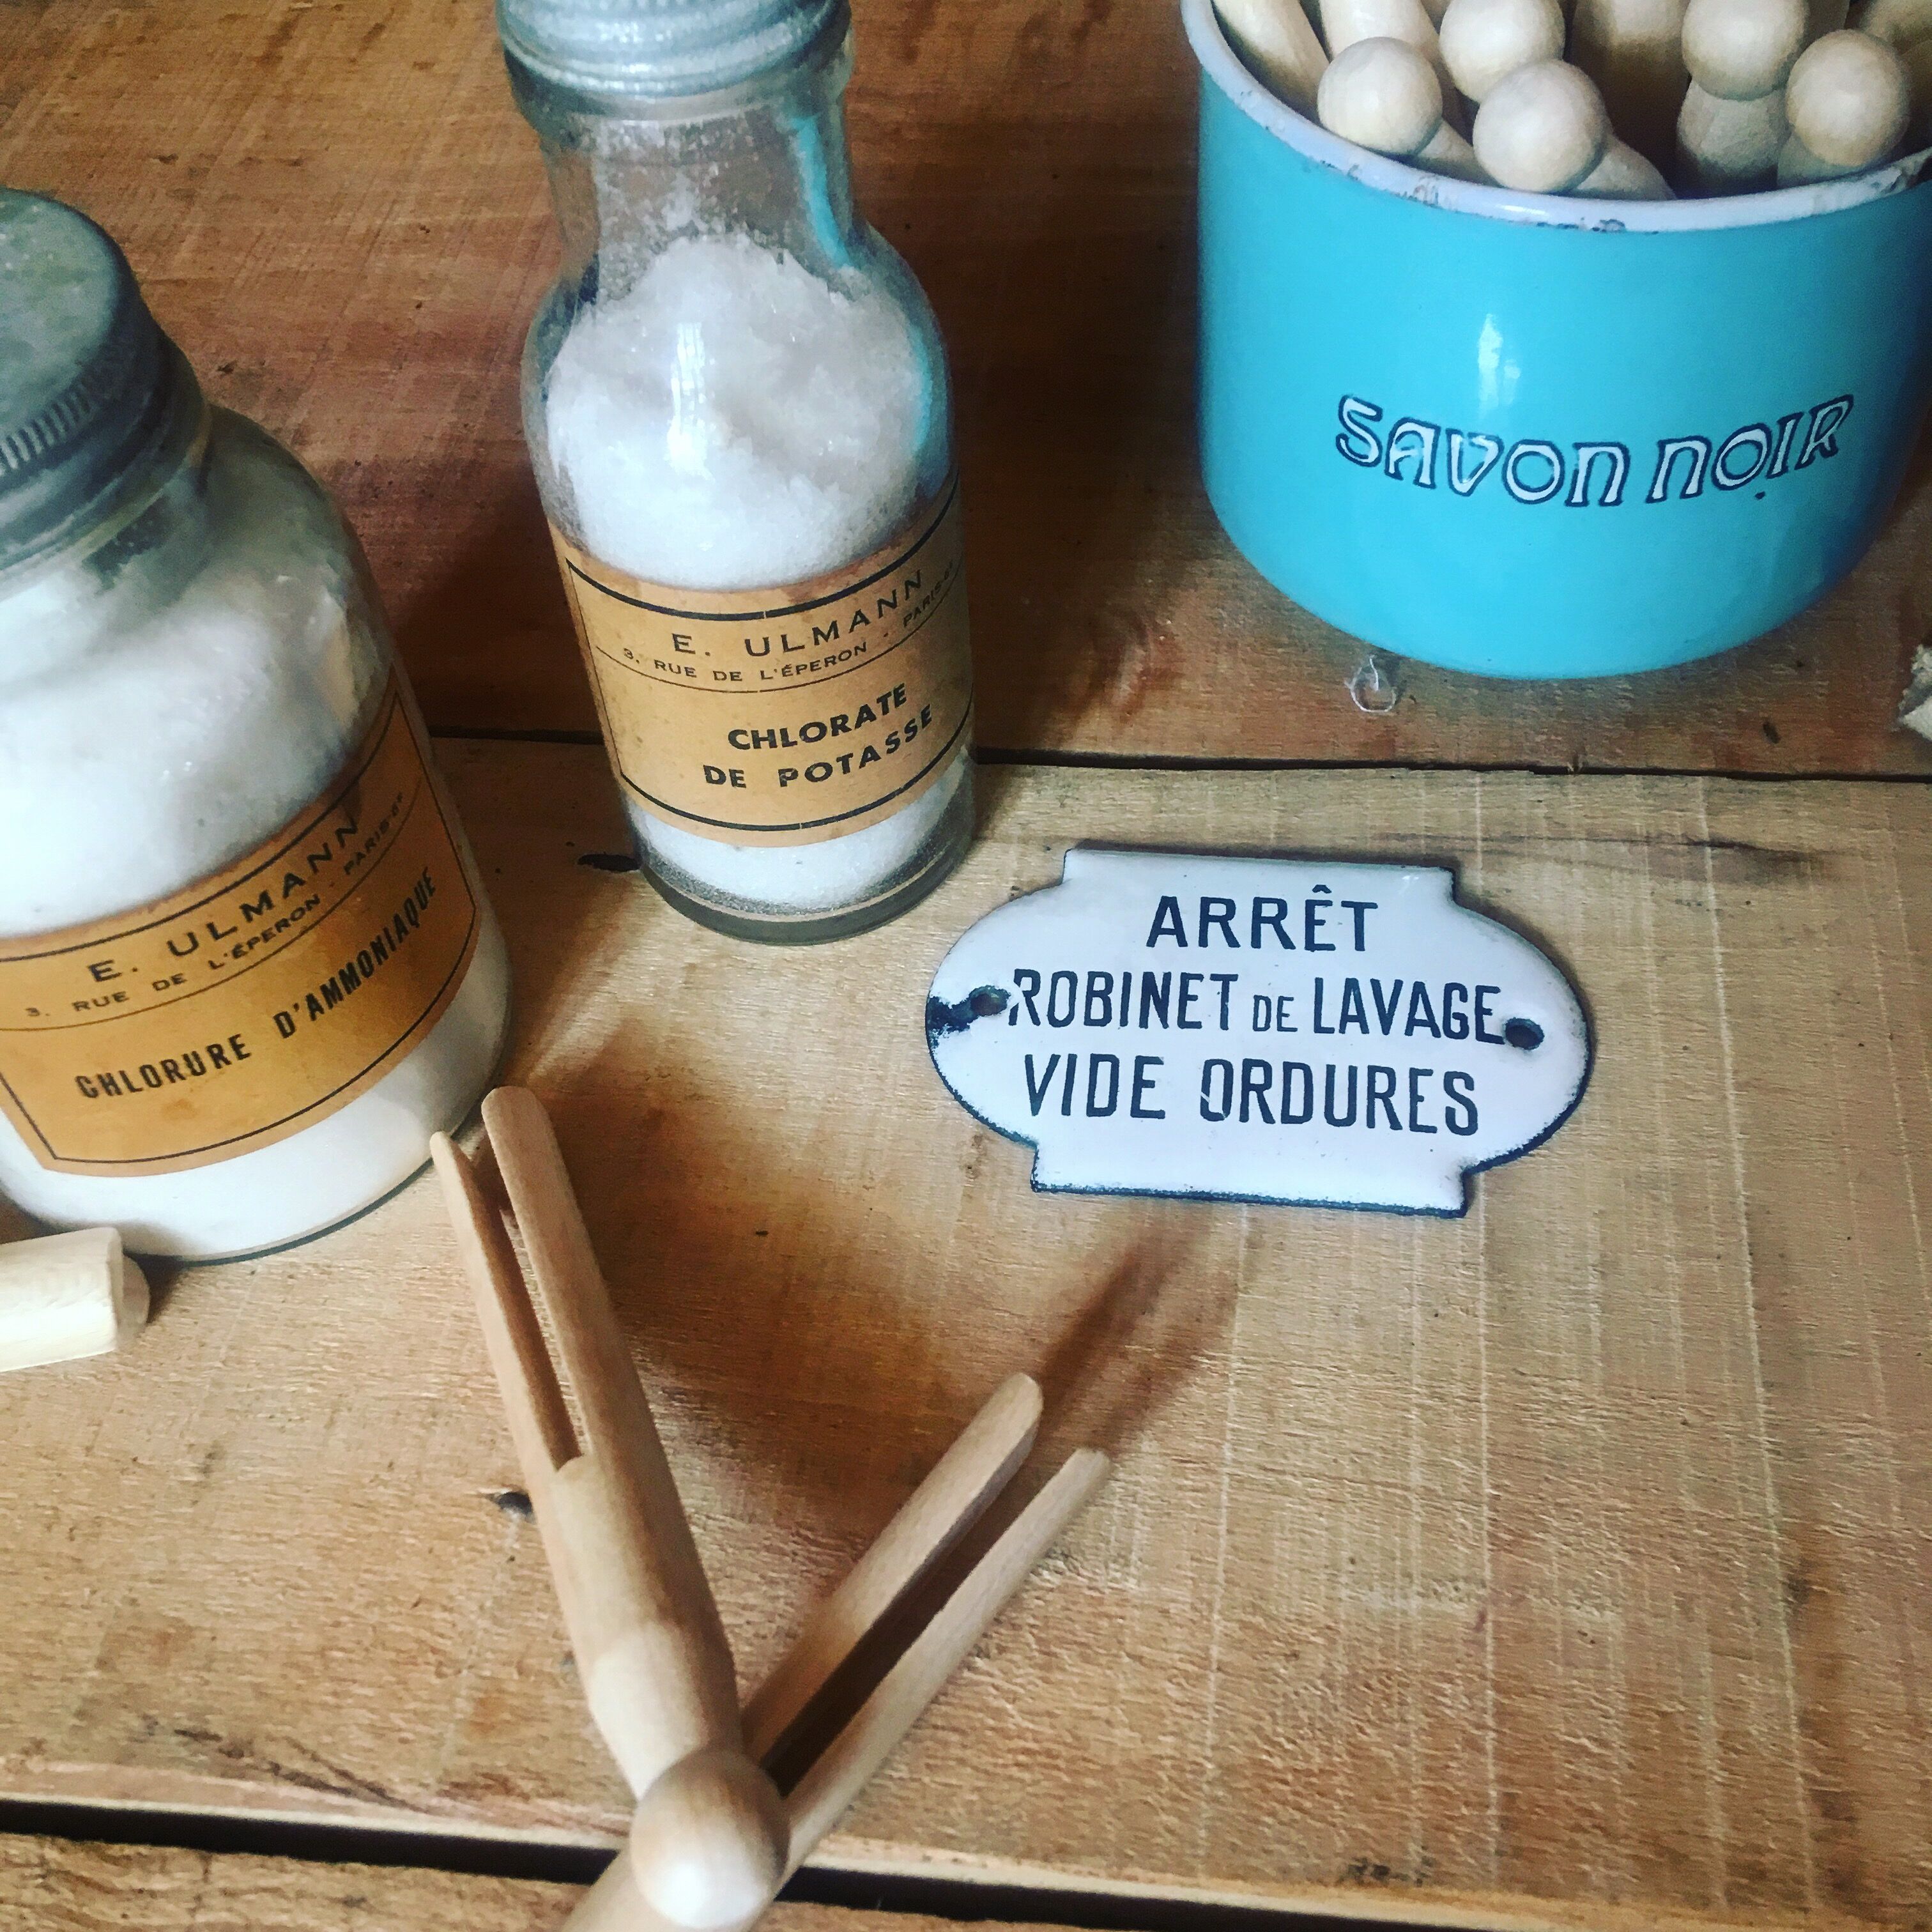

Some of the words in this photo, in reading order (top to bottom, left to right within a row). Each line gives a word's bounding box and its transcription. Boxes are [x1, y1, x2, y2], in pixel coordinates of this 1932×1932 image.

[671, 632, 711, 657] E.
[744, 569, 922, 657] ULMANN
[654, 659, 698, 678] RUE
[712, 670, 743, 682] DE
[760, 641, 868, 680] L'ÉPERON
[703, 765, 747, 788] DE
[778, 704, 933, 787] POTASSE
[728, 682, 907, 750] CHLORATE
[87, 959, 139, 982] E.
[167, 809, 358, 956] ULMANN
[1147, 884, 1379, 952] ARRÊT
[71, 991, 130, 1013] RUE
[151, 972, 188, 992] DE
[75, 1033, 252, 1098] CHLORURE
[273, 866, 436, 1039] D'AMMONIAQUE
[1008, 968, 1238, 1032] ROBINET
[1252, 995, 1298, 1033] DE
[1314, 977, 1506, 1045] LAVAGE
[1024, 1053, 1165, 1119] VIDE
[1200, 1057, 1480, 1136] ORDURES
